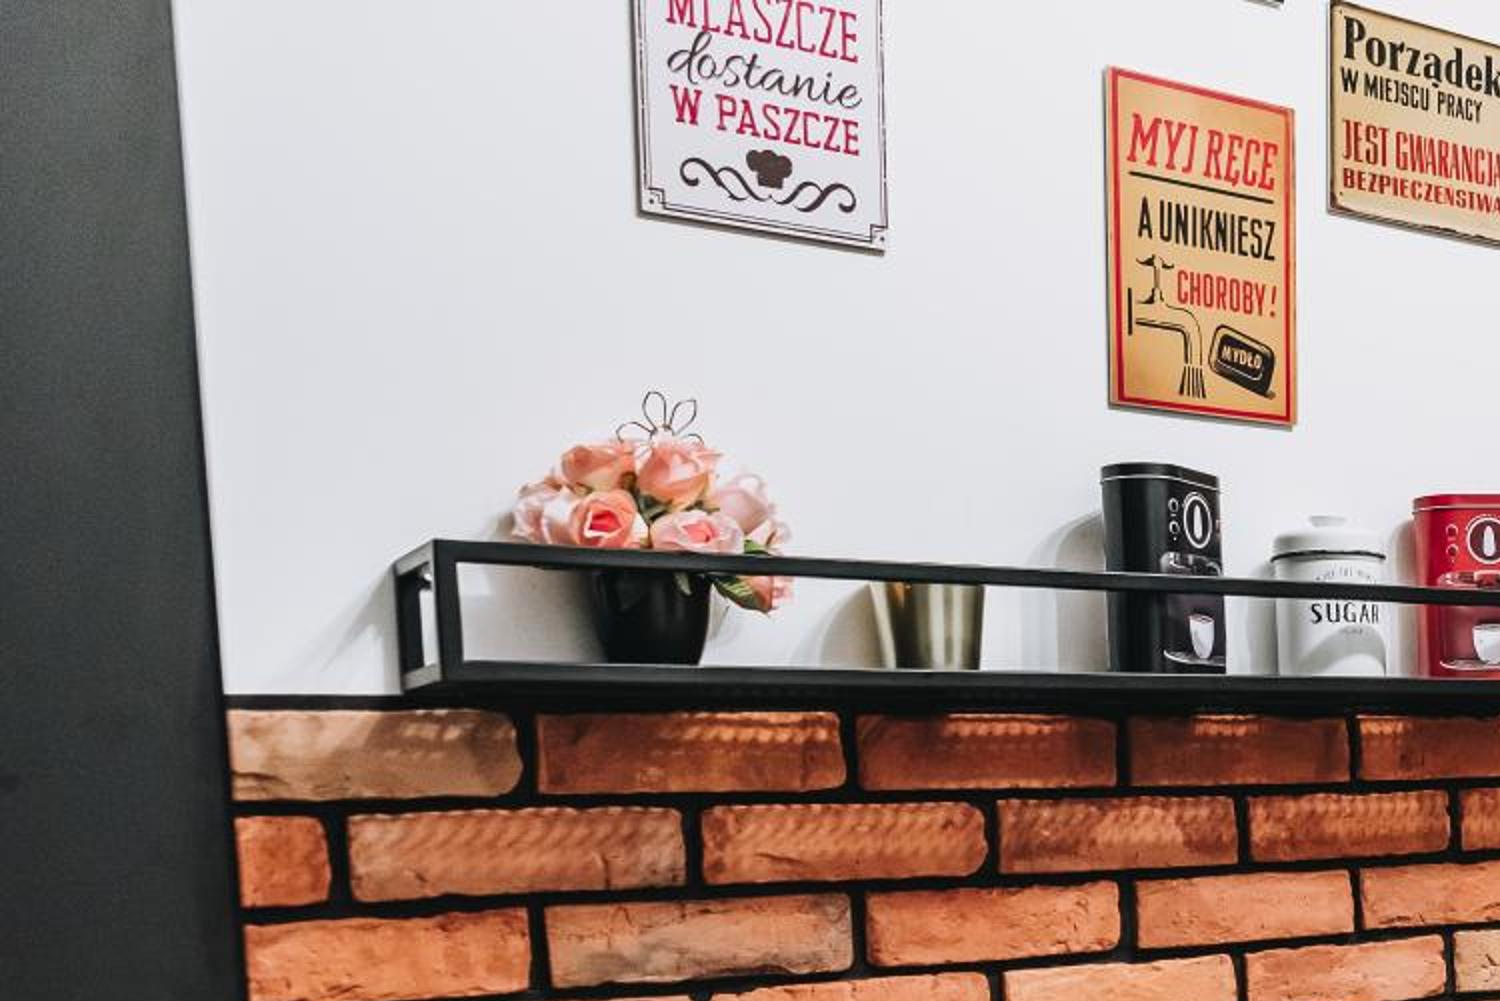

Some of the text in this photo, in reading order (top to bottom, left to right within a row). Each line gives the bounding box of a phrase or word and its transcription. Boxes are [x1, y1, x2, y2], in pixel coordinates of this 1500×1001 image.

[667, 31, 862, 109] dostanie
[1341, 66, 1484, 124] W MIEJSCU PRACY
[669, 84, 860, 157] W PASZCZE
[1126, 112, 1279, 192] MYJ RĘCE
[1342, 118, 1390, 168] JEST
[1138, 195, 1276, 262] A UNIKNIESZ
[1311, 601, 1379, 625] SUGAR
